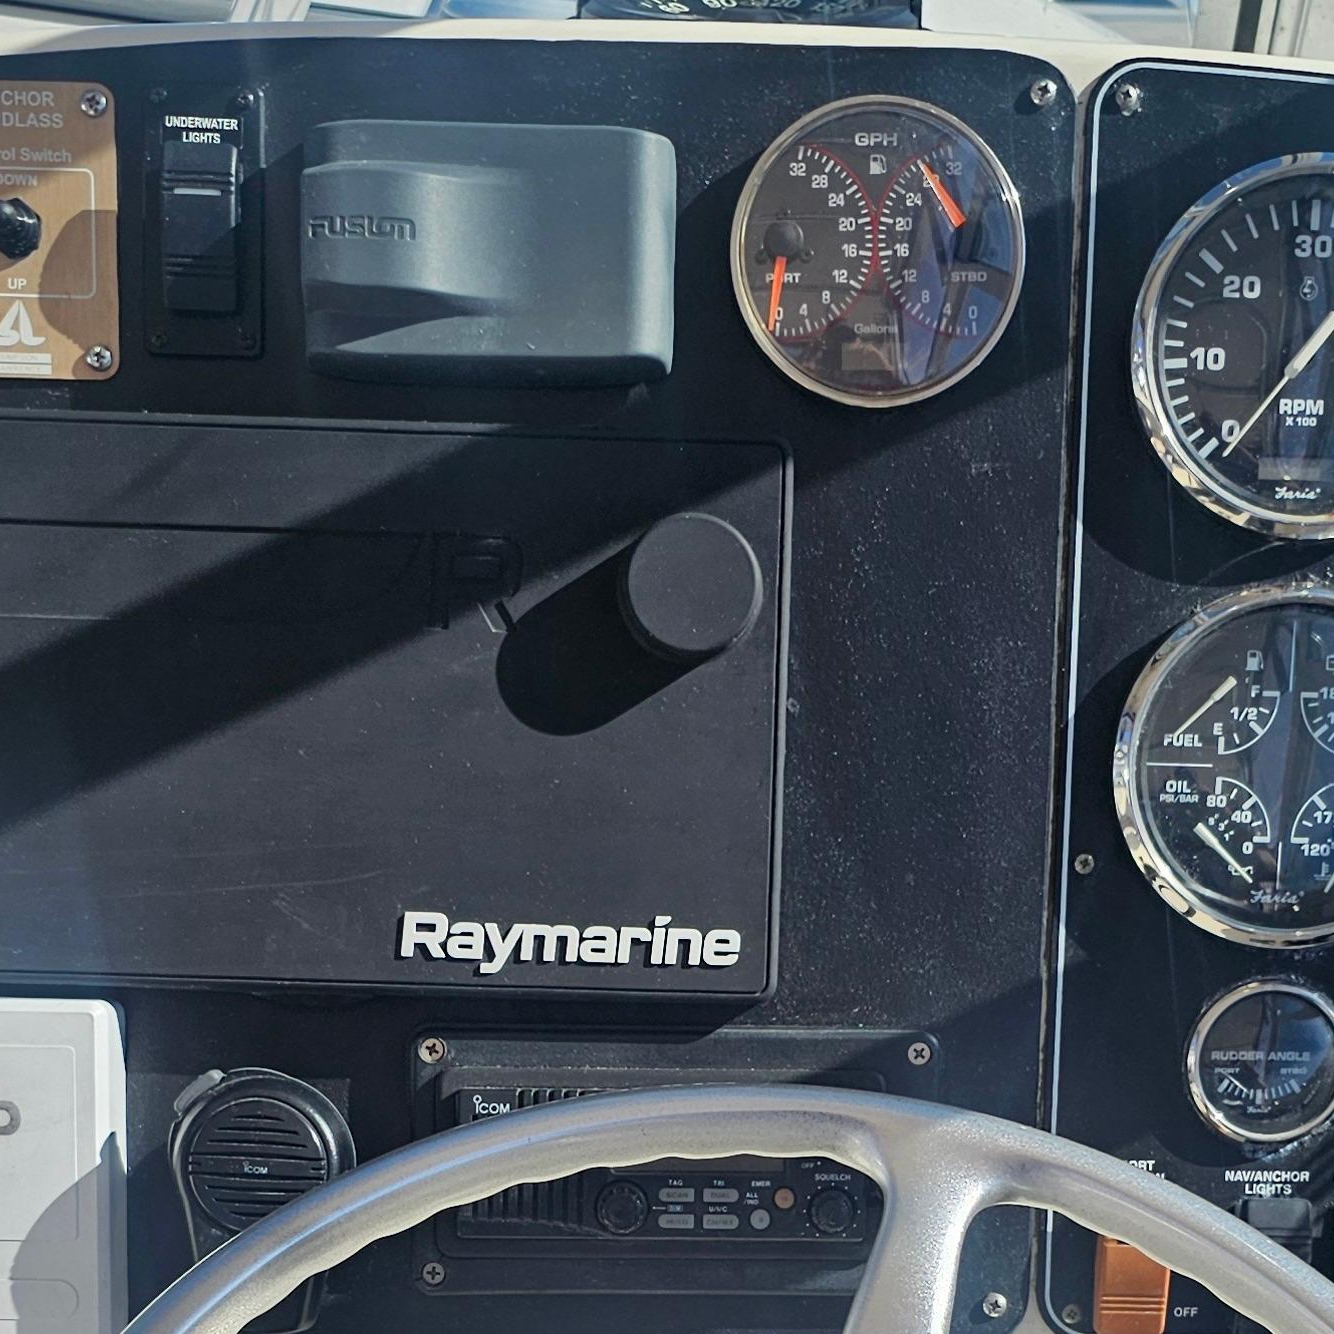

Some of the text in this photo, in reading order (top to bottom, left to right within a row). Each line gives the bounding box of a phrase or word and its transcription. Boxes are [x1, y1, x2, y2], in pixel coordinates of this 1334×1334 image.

[165, 116, 238, 130] UNDERWATER
[183, 131, 220, 144] LIGHTS
[855, 133, 898, 147] GPH
[20, 147, 71, 162] Switch
[789, 163, 806, 177] 32
[812, 175, 828, 189] 28
[828, 193, 845, 207] 24
[839, 218, 856, 231] 20
[842, 244, 857, 257] 16
[1294, 235, 1332, 258] 30
[833, 270, 848, 283] 12
[950, 271, 987, 282] STBD
[7, 278, 27, 290] UP
[1223, 276, 1261, 299] 20
[854, 324, 898, 334] Gallons
[1190, 347, 1225, 370] 10
[1279, 399, 1324, 415] RPM
[1297, 417, 1317, 427] 100
[1230, 707, 1258, 720] 1/2
[1163, 734, 1202, 748] FUEL
[1165, 780, 1191, 794] OIL
[1206, 795, 1226, 807] 80
[1231, 811, 1251, 823] 40
[1301, 843, 1330, 856] 120
[401, 911, 741, 974] Raymarine
[1211, 1051, 1310, 1061] RUDDER ANGLE
[1224, 1170, 1309, 1183] NAV/ANCHOR
[1245, 1183, 1292, 1195] LIGHTS
[1174, 1307, 1198, 1318] OFF
